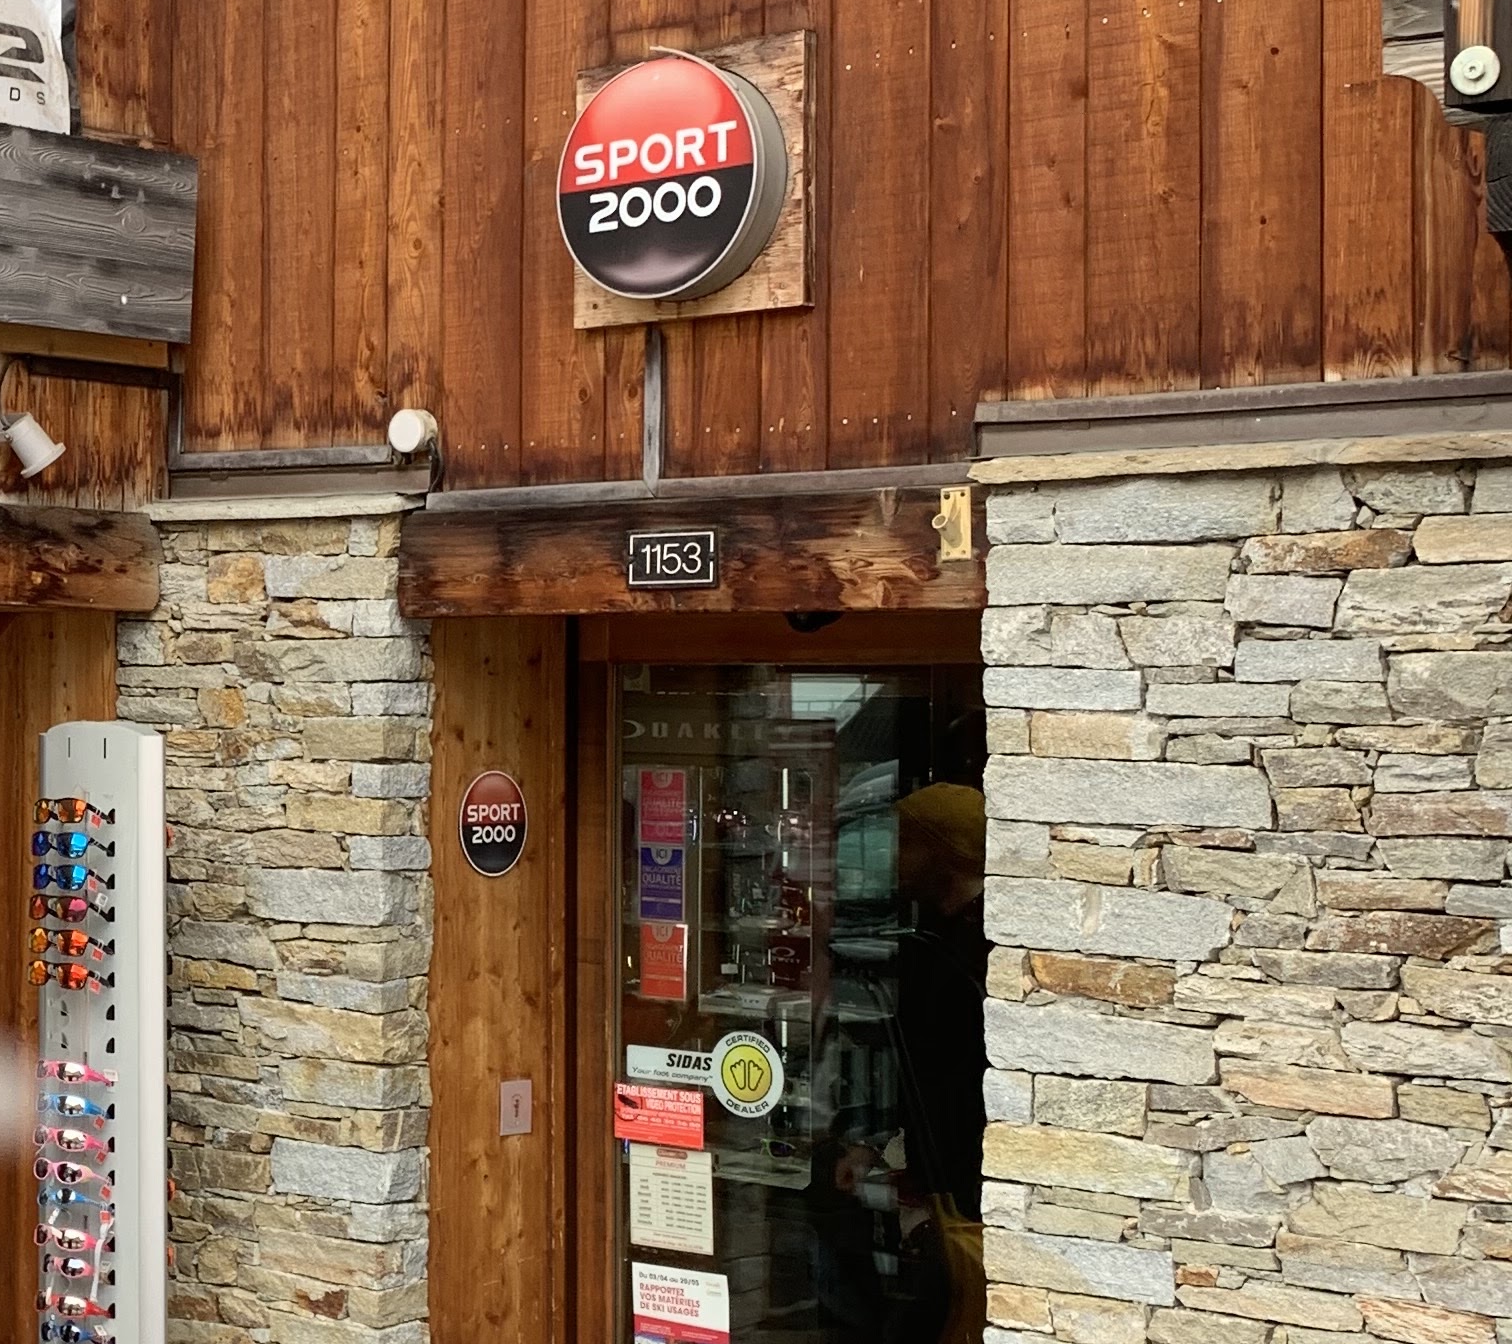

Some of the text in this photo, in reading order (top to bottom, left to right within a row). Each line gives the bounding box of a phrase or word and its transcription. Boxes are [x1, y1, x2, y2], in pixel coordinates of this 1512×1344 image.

[574, 119, 737, 186] SPORT
[589, 175, 722, 233] 2000
[641, 542, 702, 575] 1153
[467, 803, 521, 823] SPORT
[472, 825, 516, 844] 2000
[725, 1034, 771, 1054] CERTIFIED
[666, 1053, 713, 1071] SIDAS
[679, 1091, 701, 1103] SOUS
[726, 1098, 769, 1114] DEALER
[639, 1282, 685, 1296] RAPPORTEZ
[639, 1292, 656, 1302] VOS
[640, 1301, 649, 1310] DE
[652, 1303, 665, 1312] SKI
